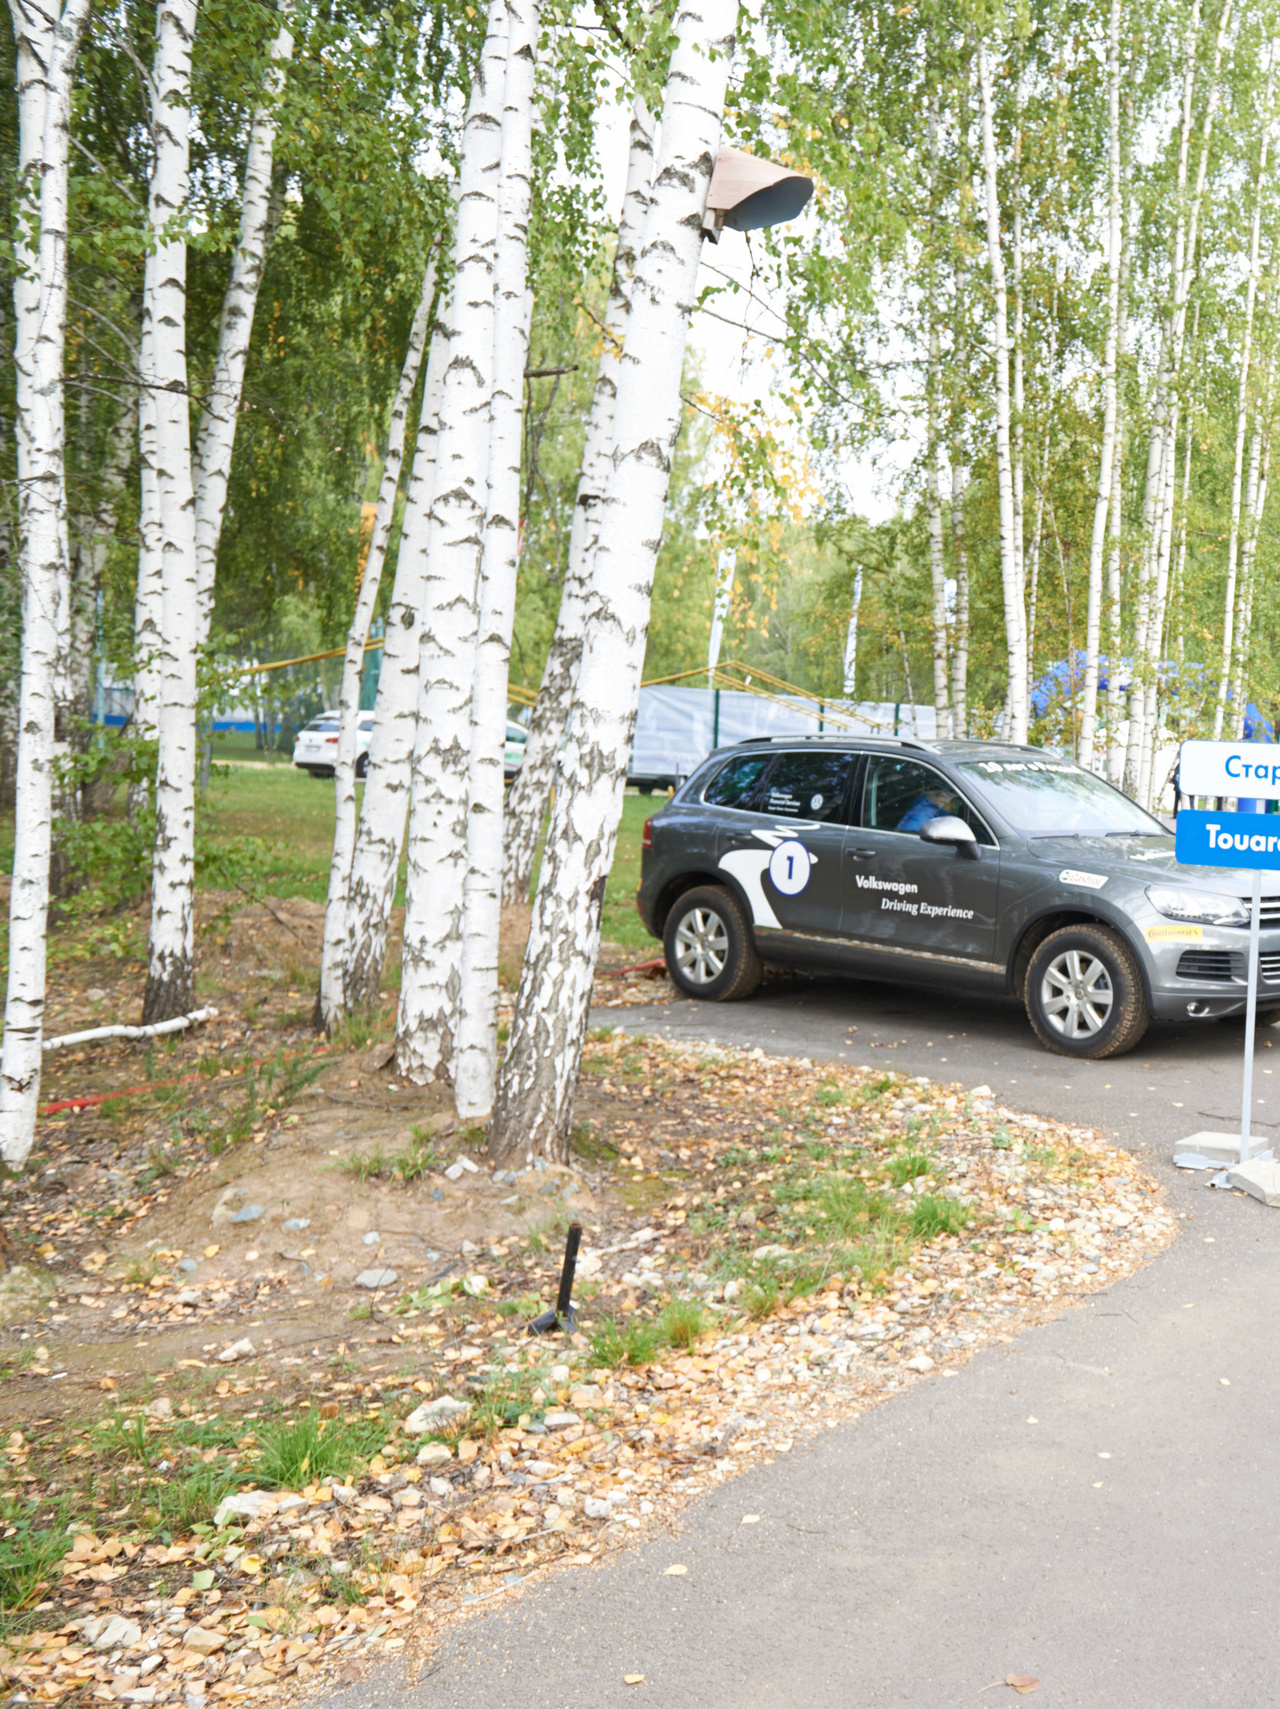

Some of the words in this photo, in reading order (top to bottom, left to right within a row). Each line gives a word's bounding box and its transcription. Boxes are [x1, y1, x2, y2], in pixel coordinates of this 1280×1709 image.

[787, 855, 794, 880] 1
[855, 874, 918, 895] Volkswagen
[1069, 872, 1101, 887] Castrol
[881, 897, 919, 916] Driving
[919, 902, 975, 919] Experience
[1148, 928, 1192, 938] Continental
